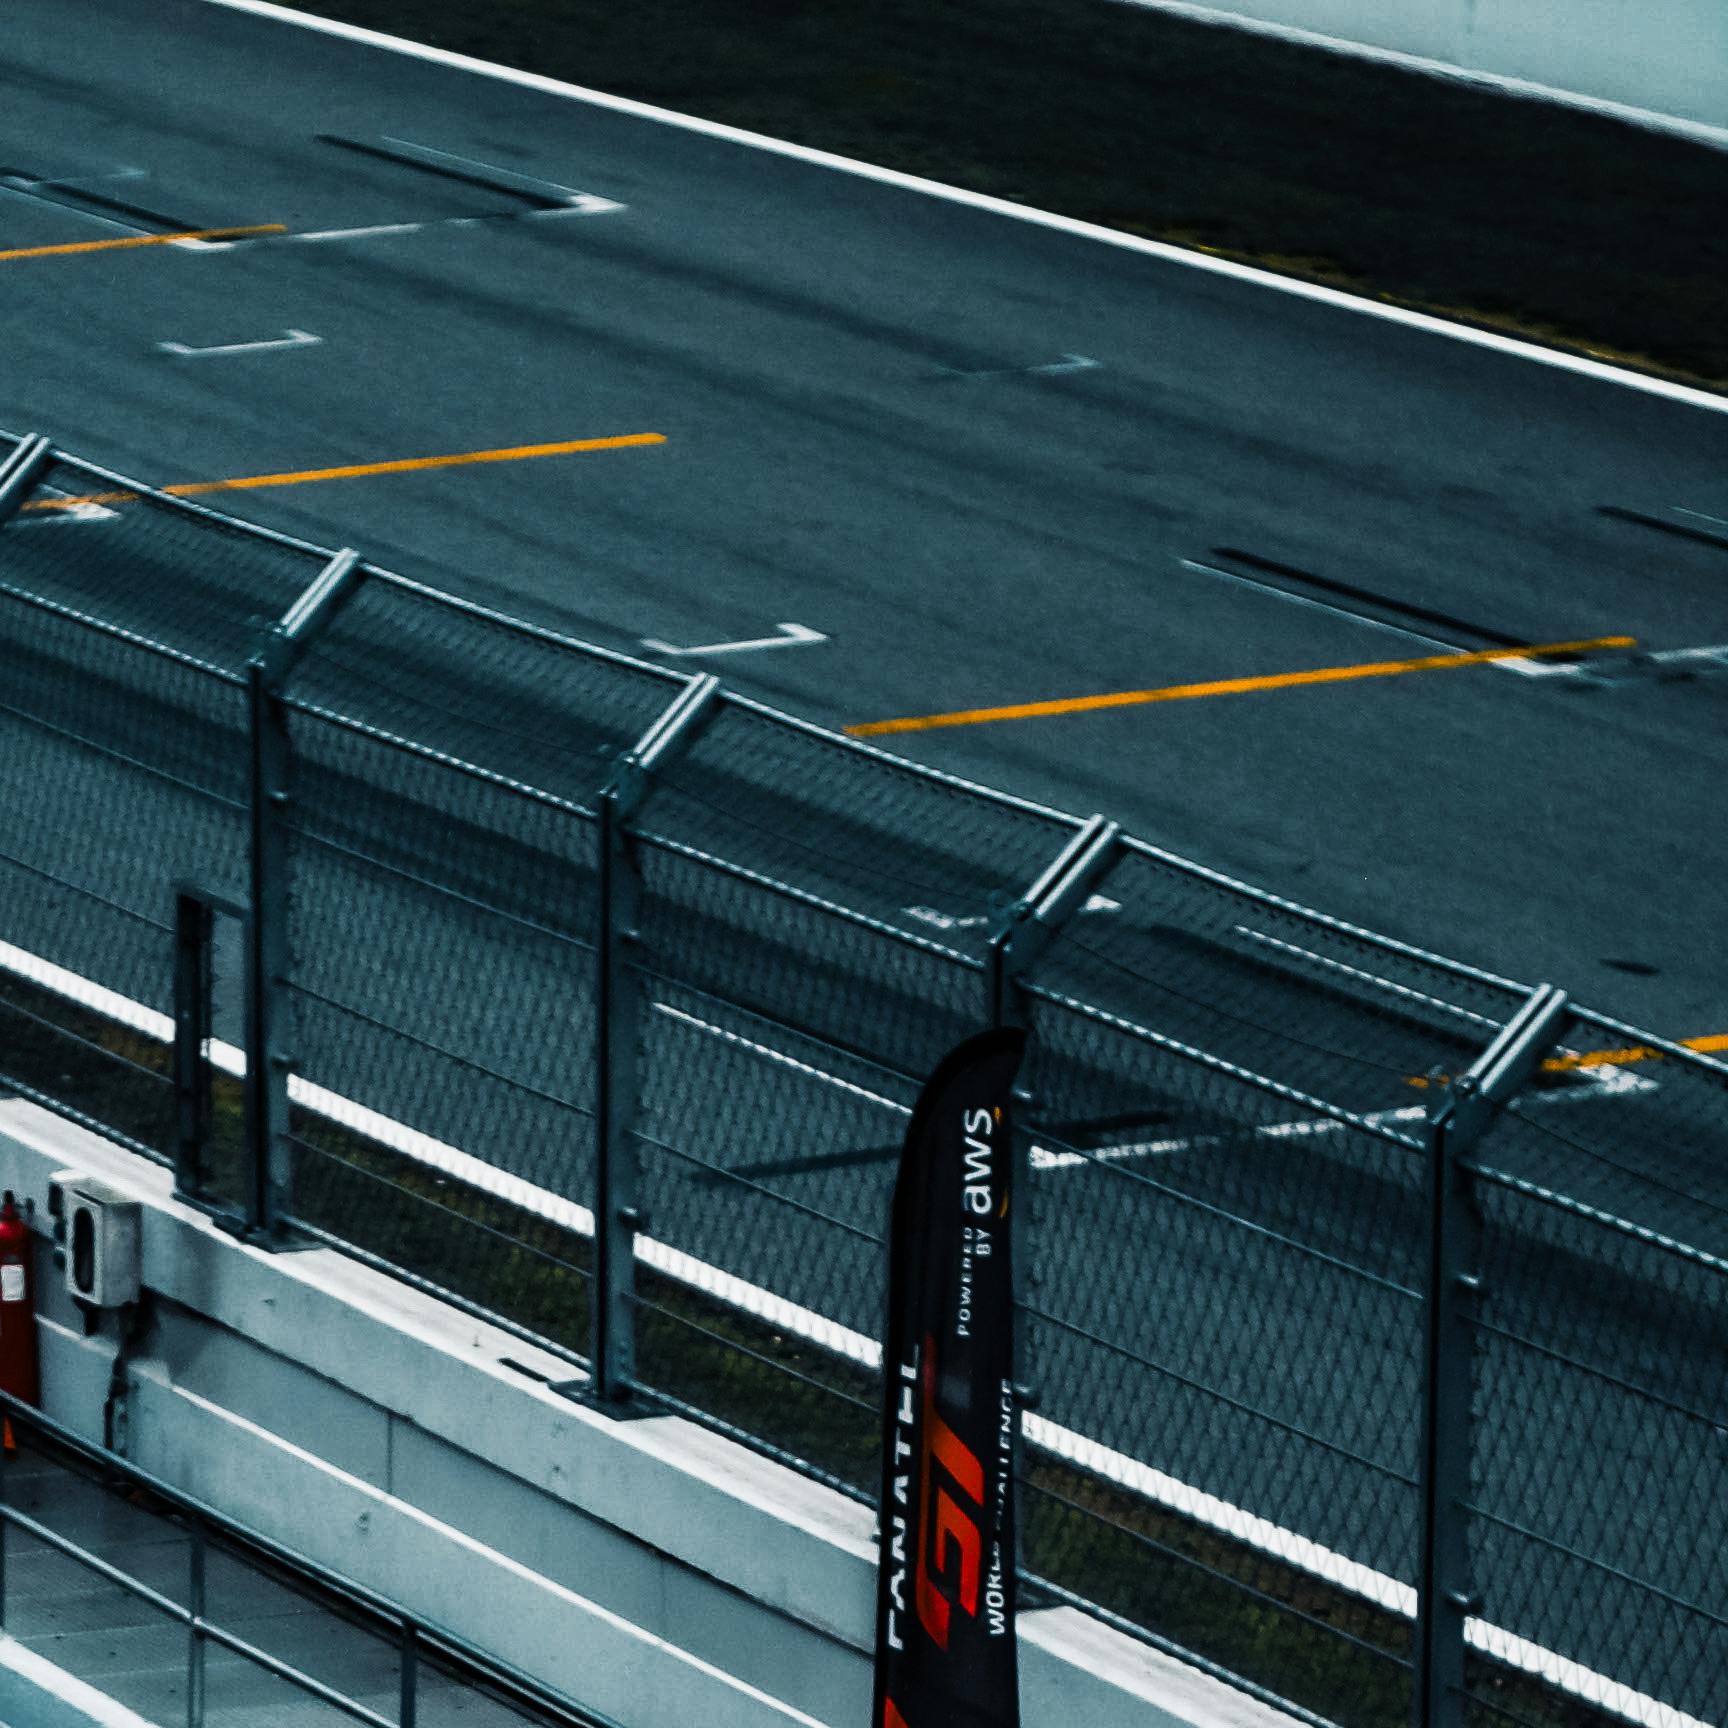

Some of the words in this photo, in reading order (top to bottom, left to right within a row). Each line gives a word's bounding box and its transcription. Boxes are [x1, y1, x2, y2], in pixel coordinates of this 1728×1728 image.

[963, 1107, 994, 1215] aws
[956, 1226, 974, 1336] POWERED
[975, 1228, 992, 1256] BY
